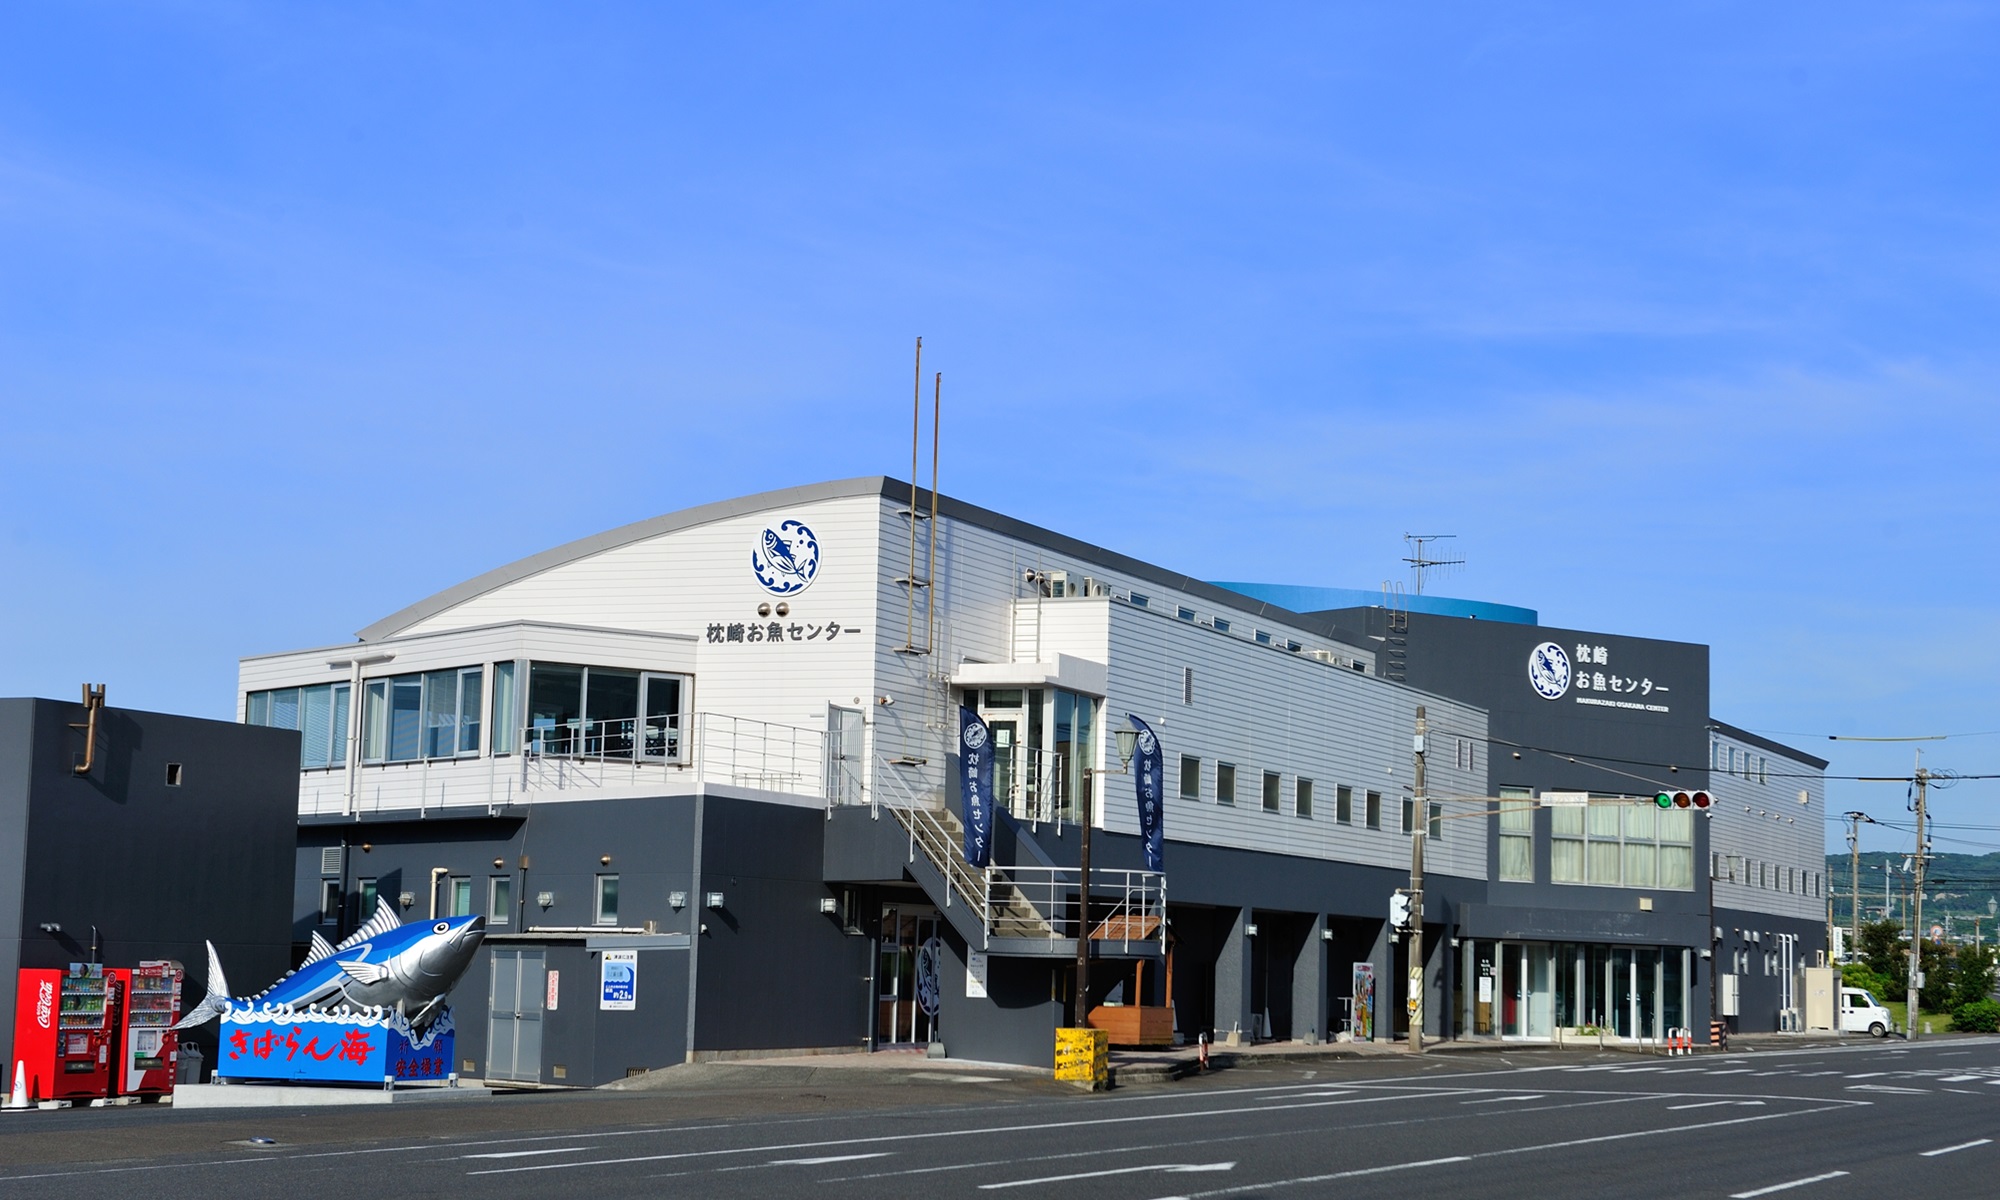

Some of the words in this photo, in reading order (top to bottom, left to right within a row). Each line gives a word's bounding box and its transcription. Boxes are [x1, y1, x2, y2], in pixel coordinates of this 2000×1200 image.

[706, 621, 861, 643] 枕崎お魚センター
[1576, 643, 1609, 665] 枕崎
[1575, 671, 1669, 696] お魚センター
[37, 979, 53, 1029] Coca-Cola
[229, 1026, 376, 1066] きばらん海
[395, 1057, 444, 1077] 安全操業
